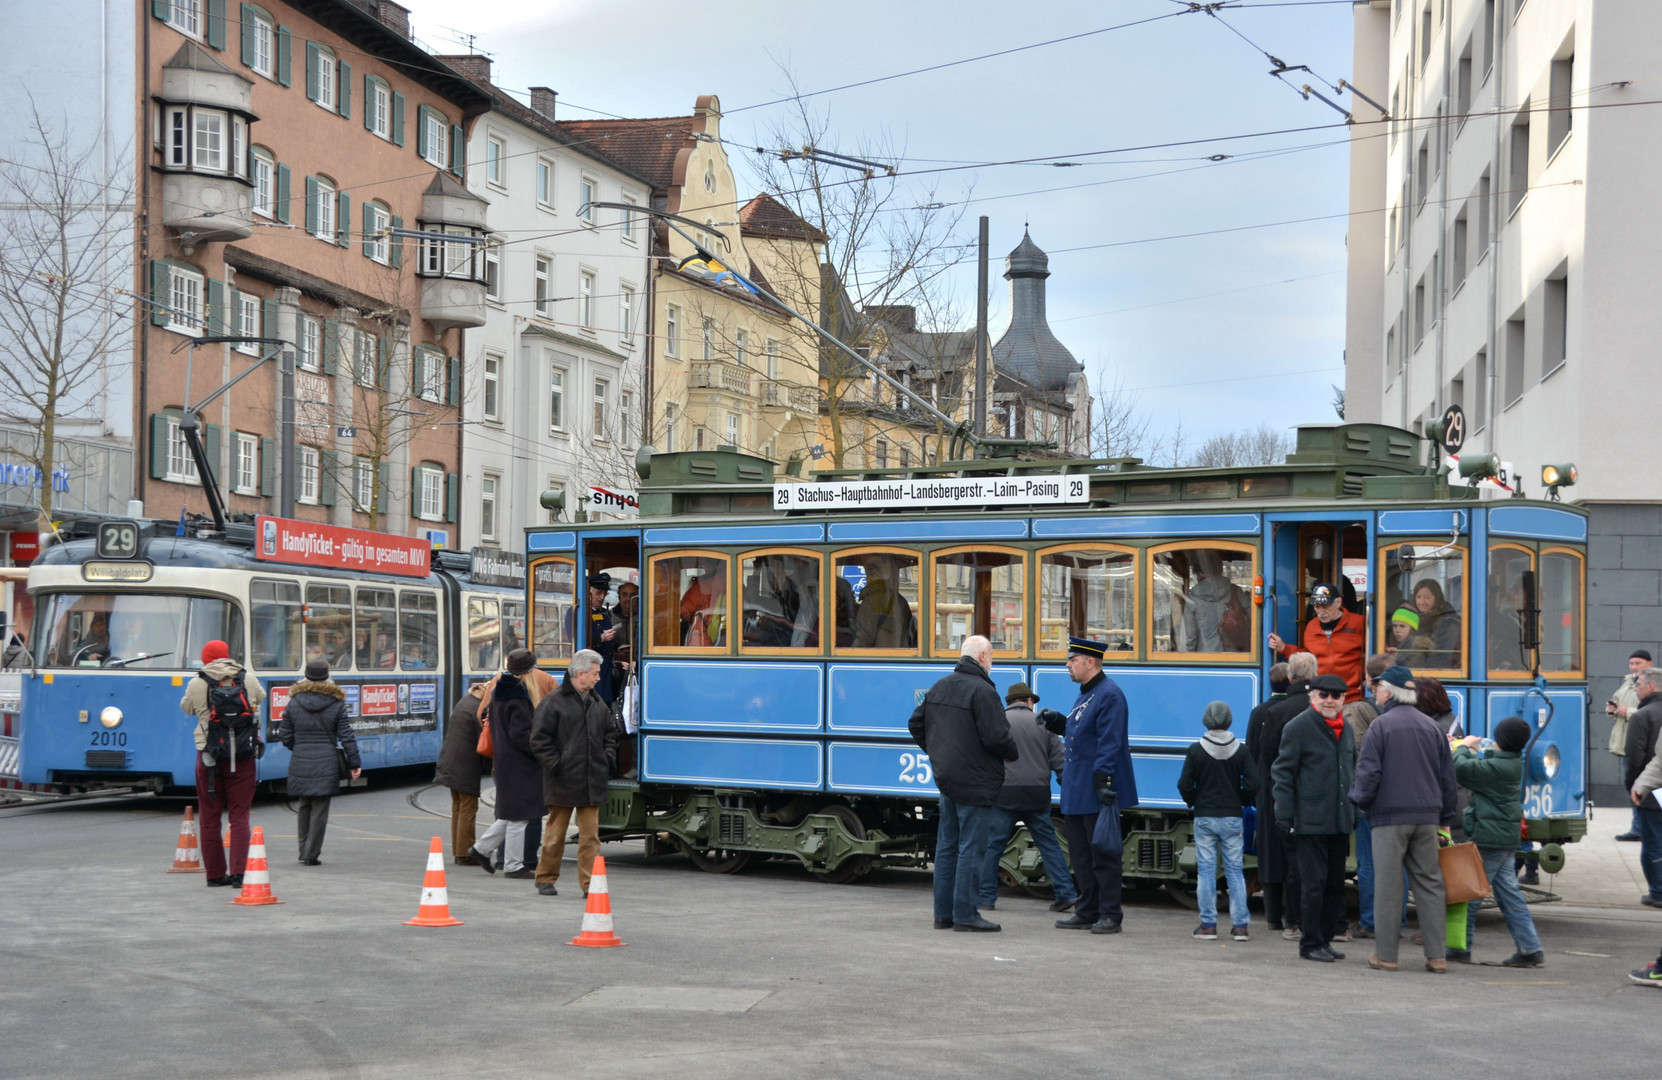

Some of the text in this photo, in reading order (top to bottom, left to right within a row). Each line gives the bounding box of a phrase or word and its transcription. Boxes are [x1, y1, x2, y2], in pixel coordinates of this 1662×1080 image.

[342, 429, 352, 437] 64
[1446, 411, 1462, 446] 29
[34, 463, 70, 493] bnk
[593, 492, 635, 510] chus
[777, 489, 789, 505] 29
[1070, 481, 1083, 497] 29
[105, 528, 134, 551] 29
[282, 530, 333, 558] HandyTicket
[342, 538, 364, 563] gültig
[365, 541, 374, 560] im
[376, 546, 408, 566] gesamten
[410, 547, 426, 567] MVV
[90, 567, 147, 578] Willibaldplatz
[488, 558, 510, 577] Fahrinfo
[362, 687, 396, 706] HandyTicket
[91, 731, 127, 747] 2010
[899, 753, 933, 784] 25
